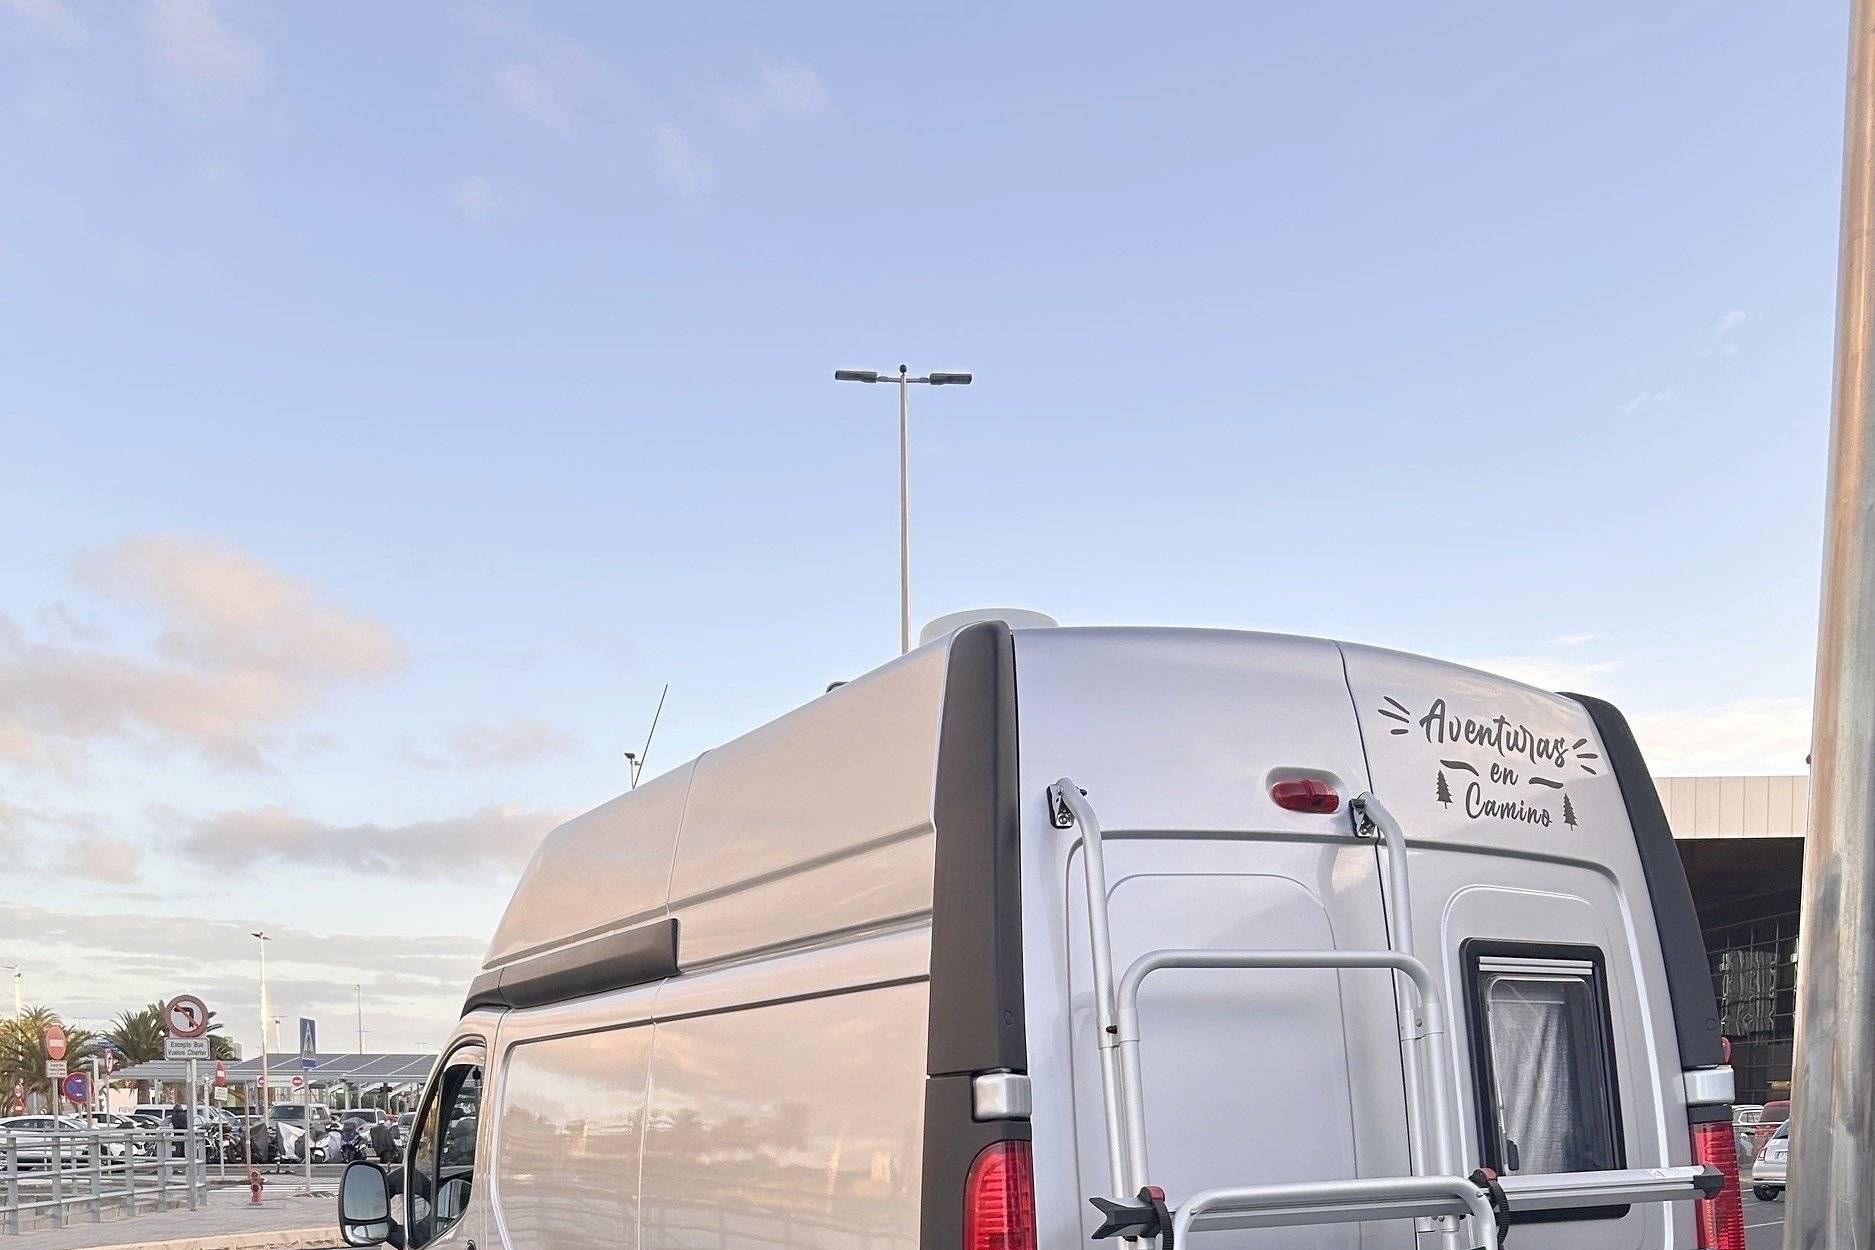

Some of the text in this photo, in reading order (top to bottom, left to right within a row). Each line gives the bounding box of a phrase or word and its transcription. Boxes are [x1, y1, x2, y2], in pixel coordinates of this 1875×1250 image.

[1419, 698, 1569, 768] Aventuras
[1490, 762, 1519, 786] en
[1465, 781, 1553, 828] Camino
